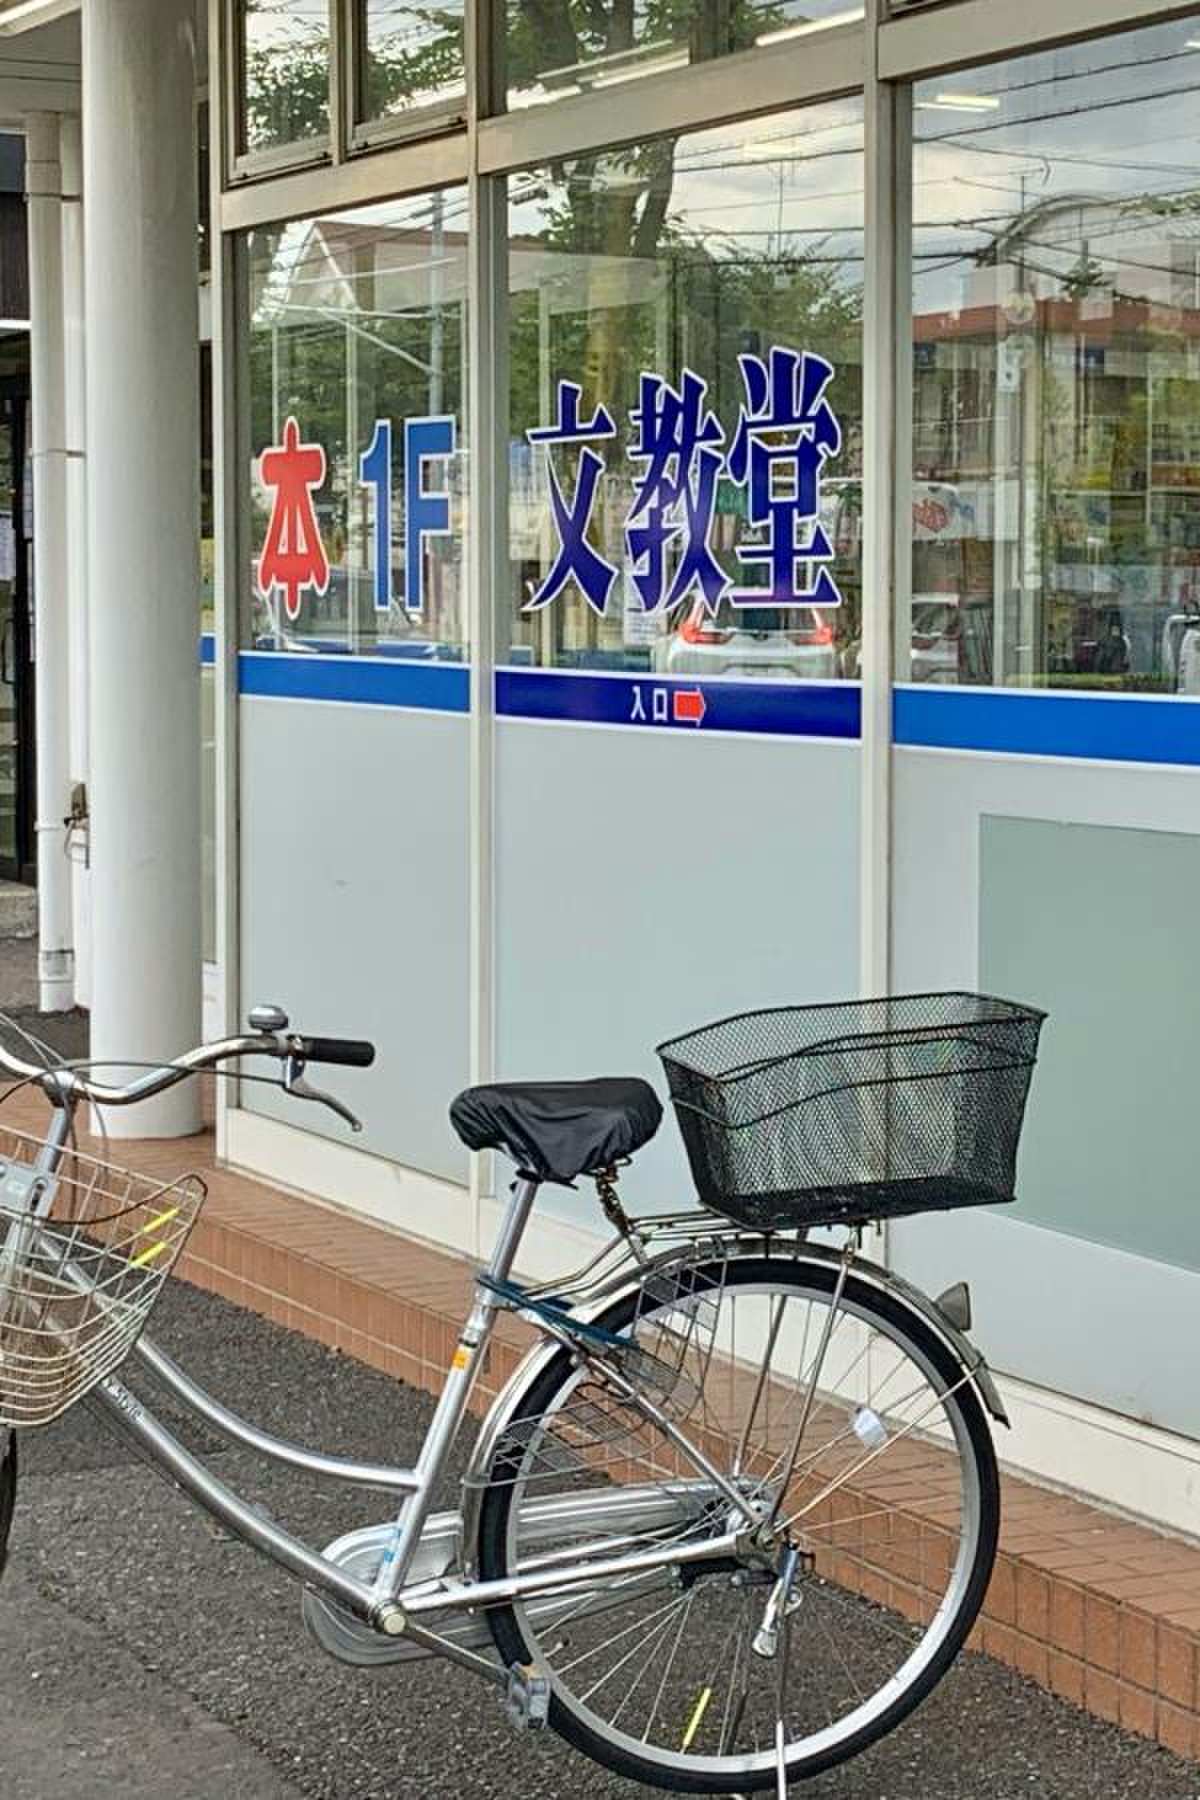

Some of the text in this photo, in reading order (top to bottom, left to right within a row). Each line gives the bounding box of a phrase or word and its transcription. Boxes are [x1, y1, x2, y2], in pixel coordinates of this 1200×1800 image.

[258, 414, 457, 620] 本 1F
[521, 346, 842, 617] 文教堂
[630, 686, 668, 722] 入口
